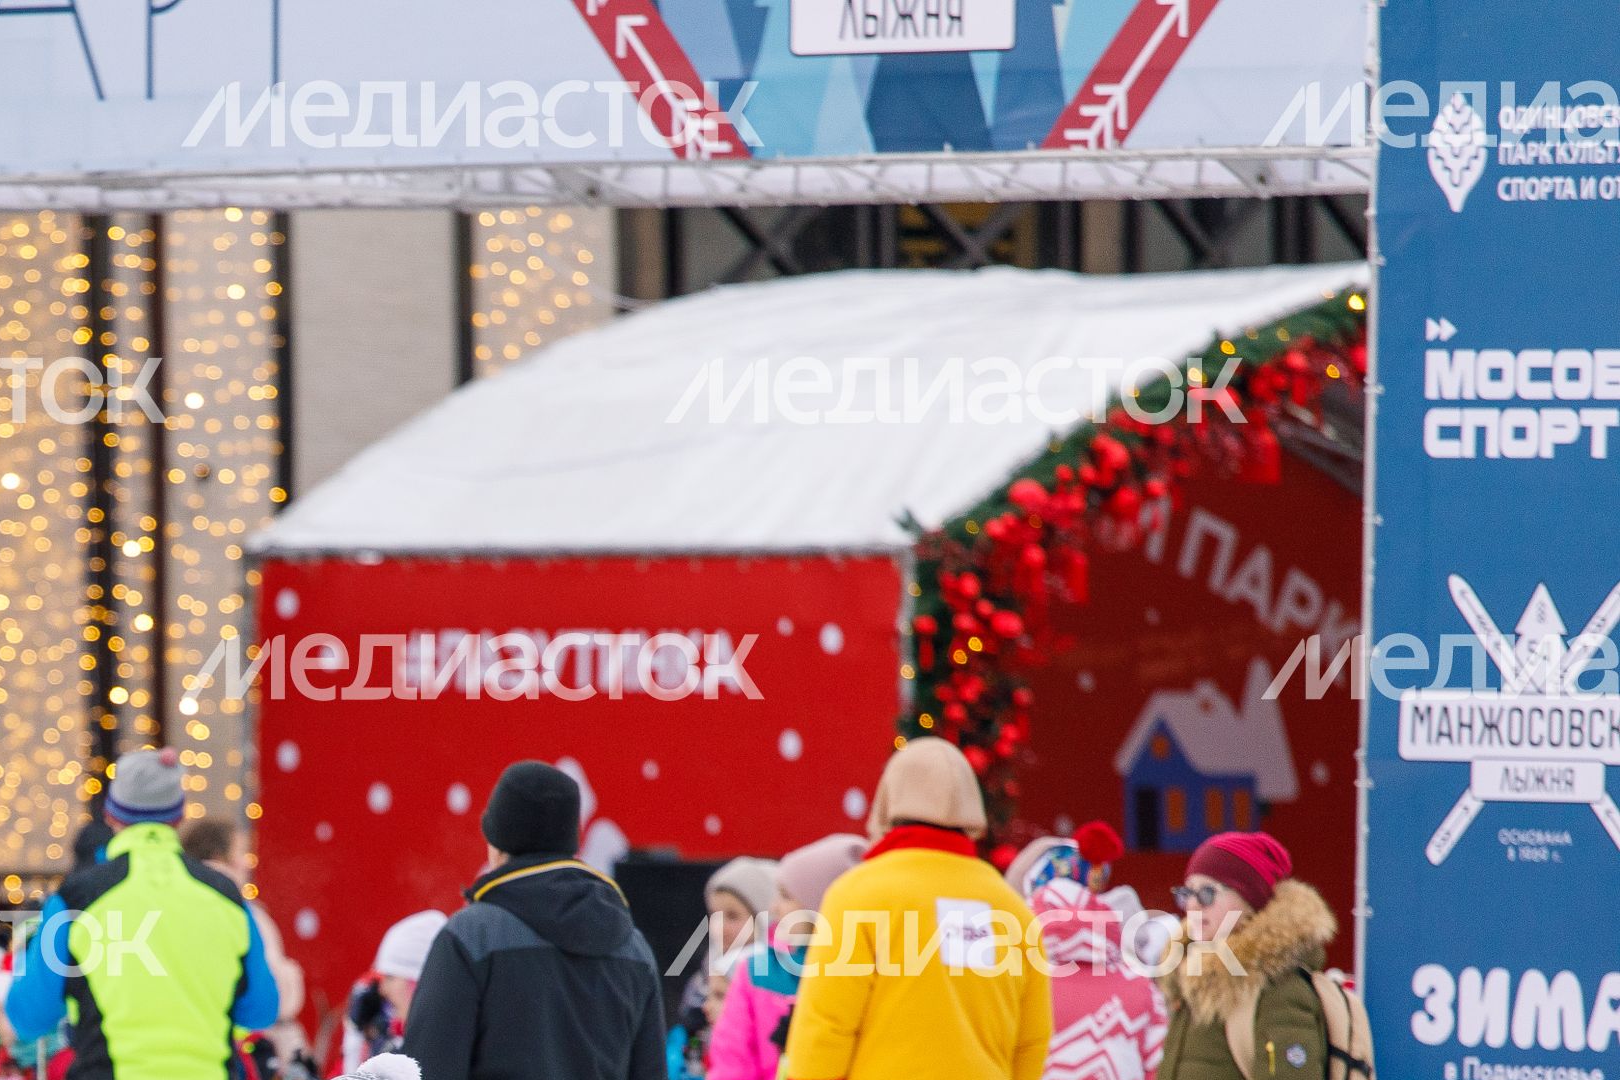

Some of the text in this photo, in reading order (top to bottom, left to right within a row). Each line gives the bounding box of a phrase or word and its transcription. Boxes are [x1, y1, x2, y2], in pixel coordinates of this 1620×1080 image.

[838, 0, 966, 41] ЛЫЖНЯ
[1498, 142, 1554, 166] ПАРК
[1497, 176, 1578, 201] СПОРТА
[1580, 176, 1597, 200] И
[1423, 408, 1620, 460] СПОРТ
[1499, 766, 1576, 794] ЛЫЖНЯ
